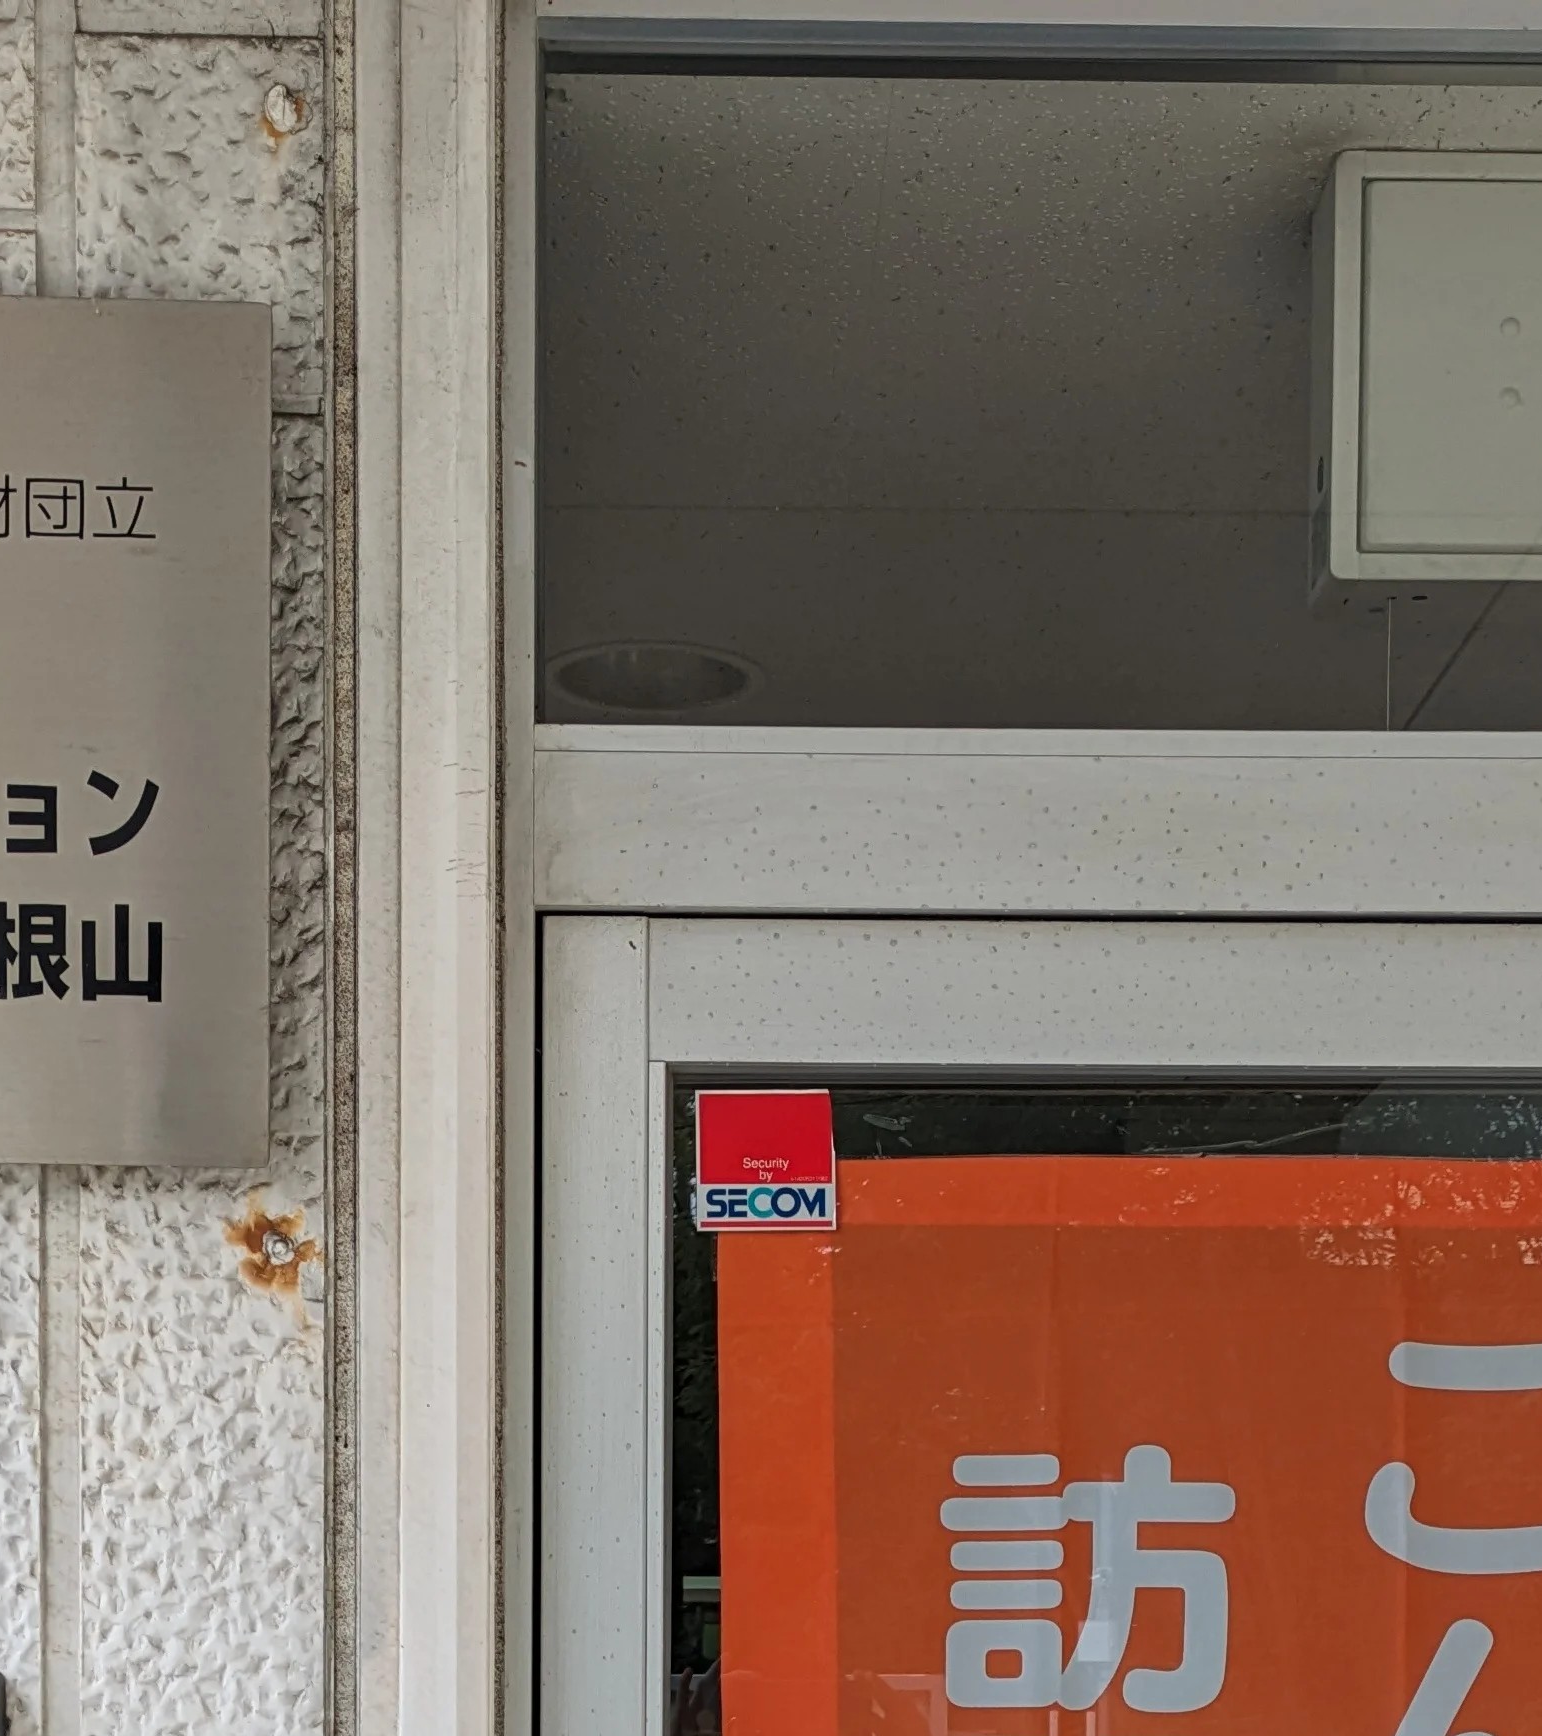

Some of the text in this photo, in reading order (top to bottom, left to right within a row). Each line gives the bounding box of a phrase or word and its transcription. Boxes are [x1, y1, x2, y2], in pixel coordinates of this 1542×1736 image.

[743, 1157, 789, 1171] Security
[759, 1170, 773, 1182] by
[706, 1187, 826, 1218] SECOM
